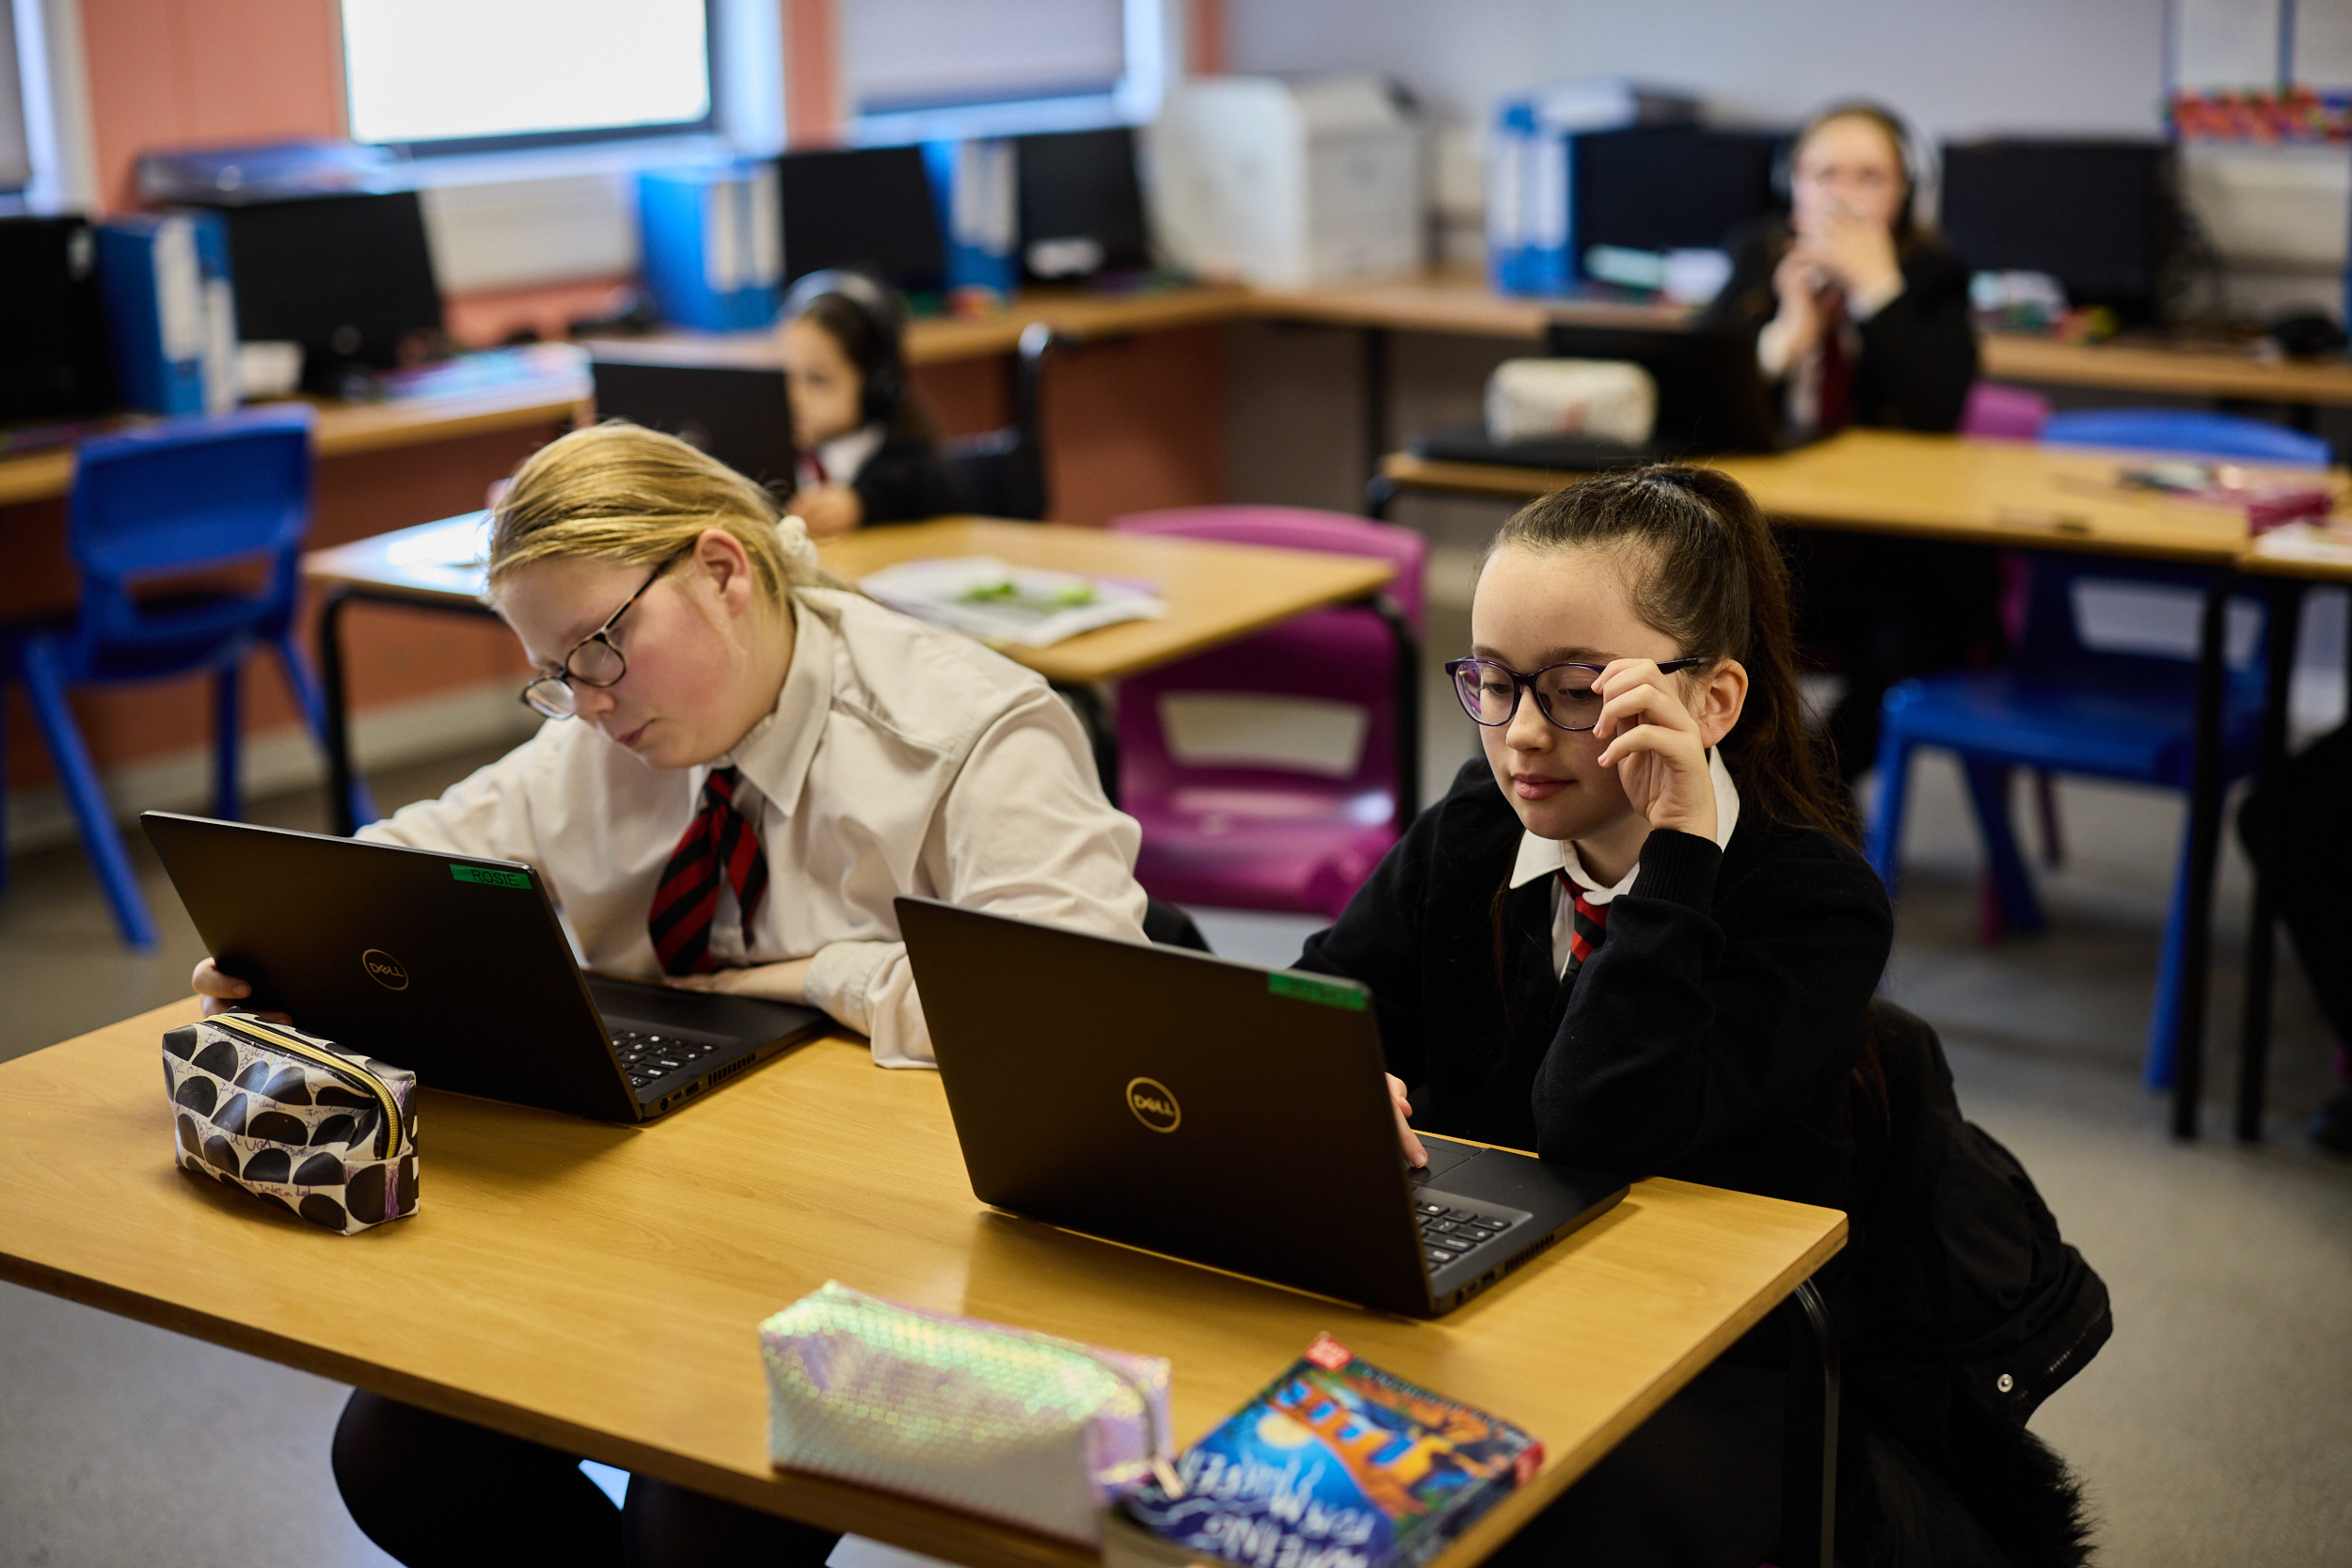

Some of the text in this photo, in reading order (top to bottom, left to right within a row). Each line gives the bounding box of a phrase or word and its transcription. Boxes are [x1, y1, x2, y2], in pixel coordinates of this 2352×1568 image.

[470, 869, 519, 887] ROSIE
[369, 961, 405, 978] DELL
[1133, 1093, 1177, 1118] DELL
